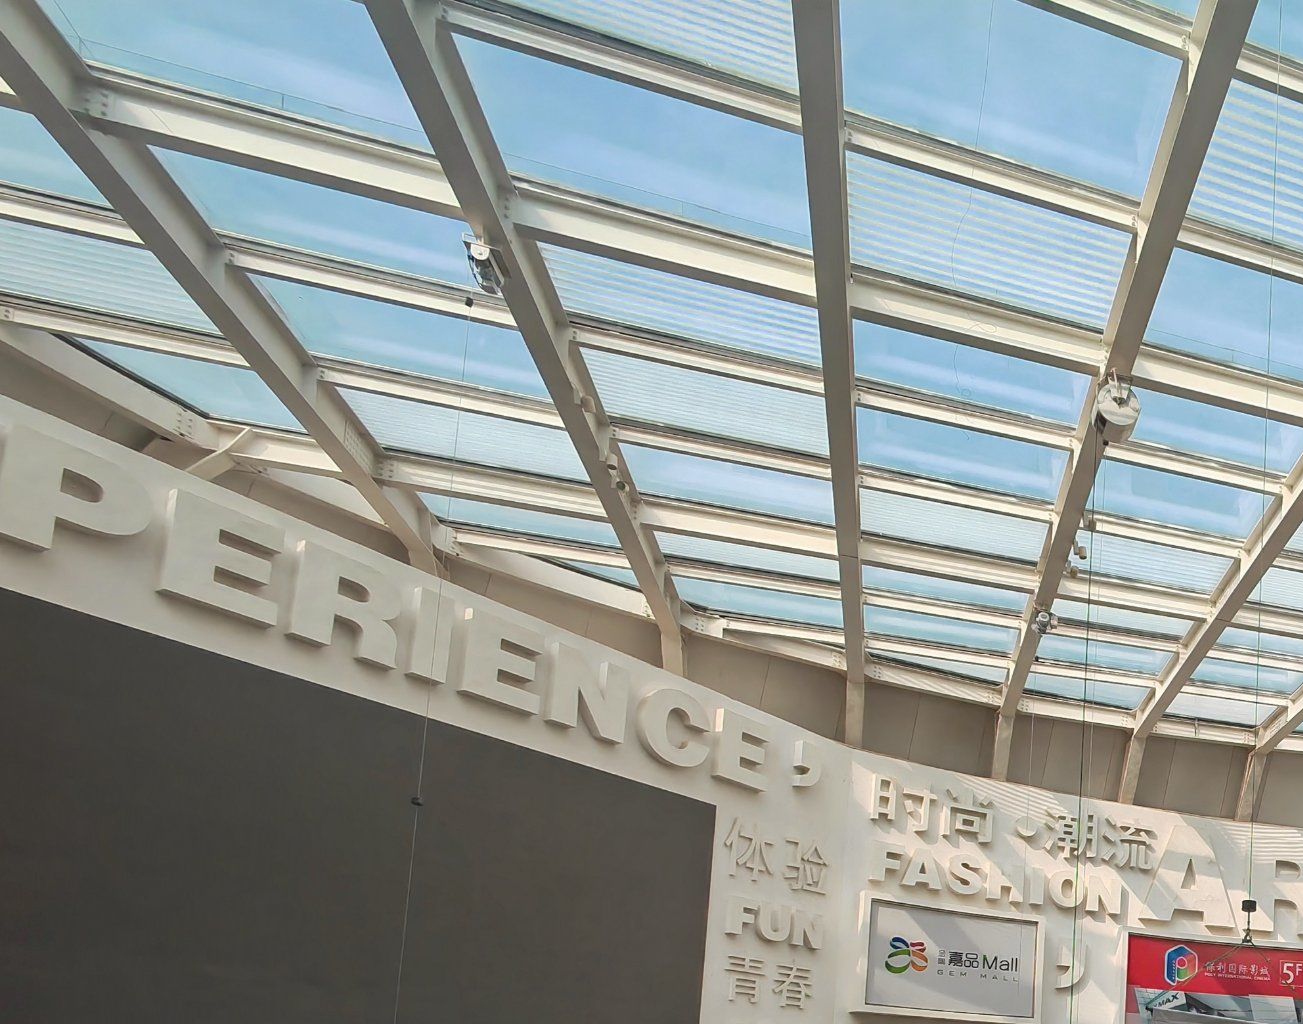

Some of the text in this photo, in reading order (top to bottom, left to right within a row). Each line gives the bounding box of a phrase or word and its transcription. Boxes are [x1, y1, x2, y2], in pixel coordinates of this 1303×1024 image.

[723, 817, 829, 895] 体验
[868, 842, 1127, 915] FASHION
[724, 903, 824, 950] FUN
[724, 954, 813, 1010] 青春
[937, 969, 1019, 983] GEM MALL
[1281, 962, 1303, 984] 5F
